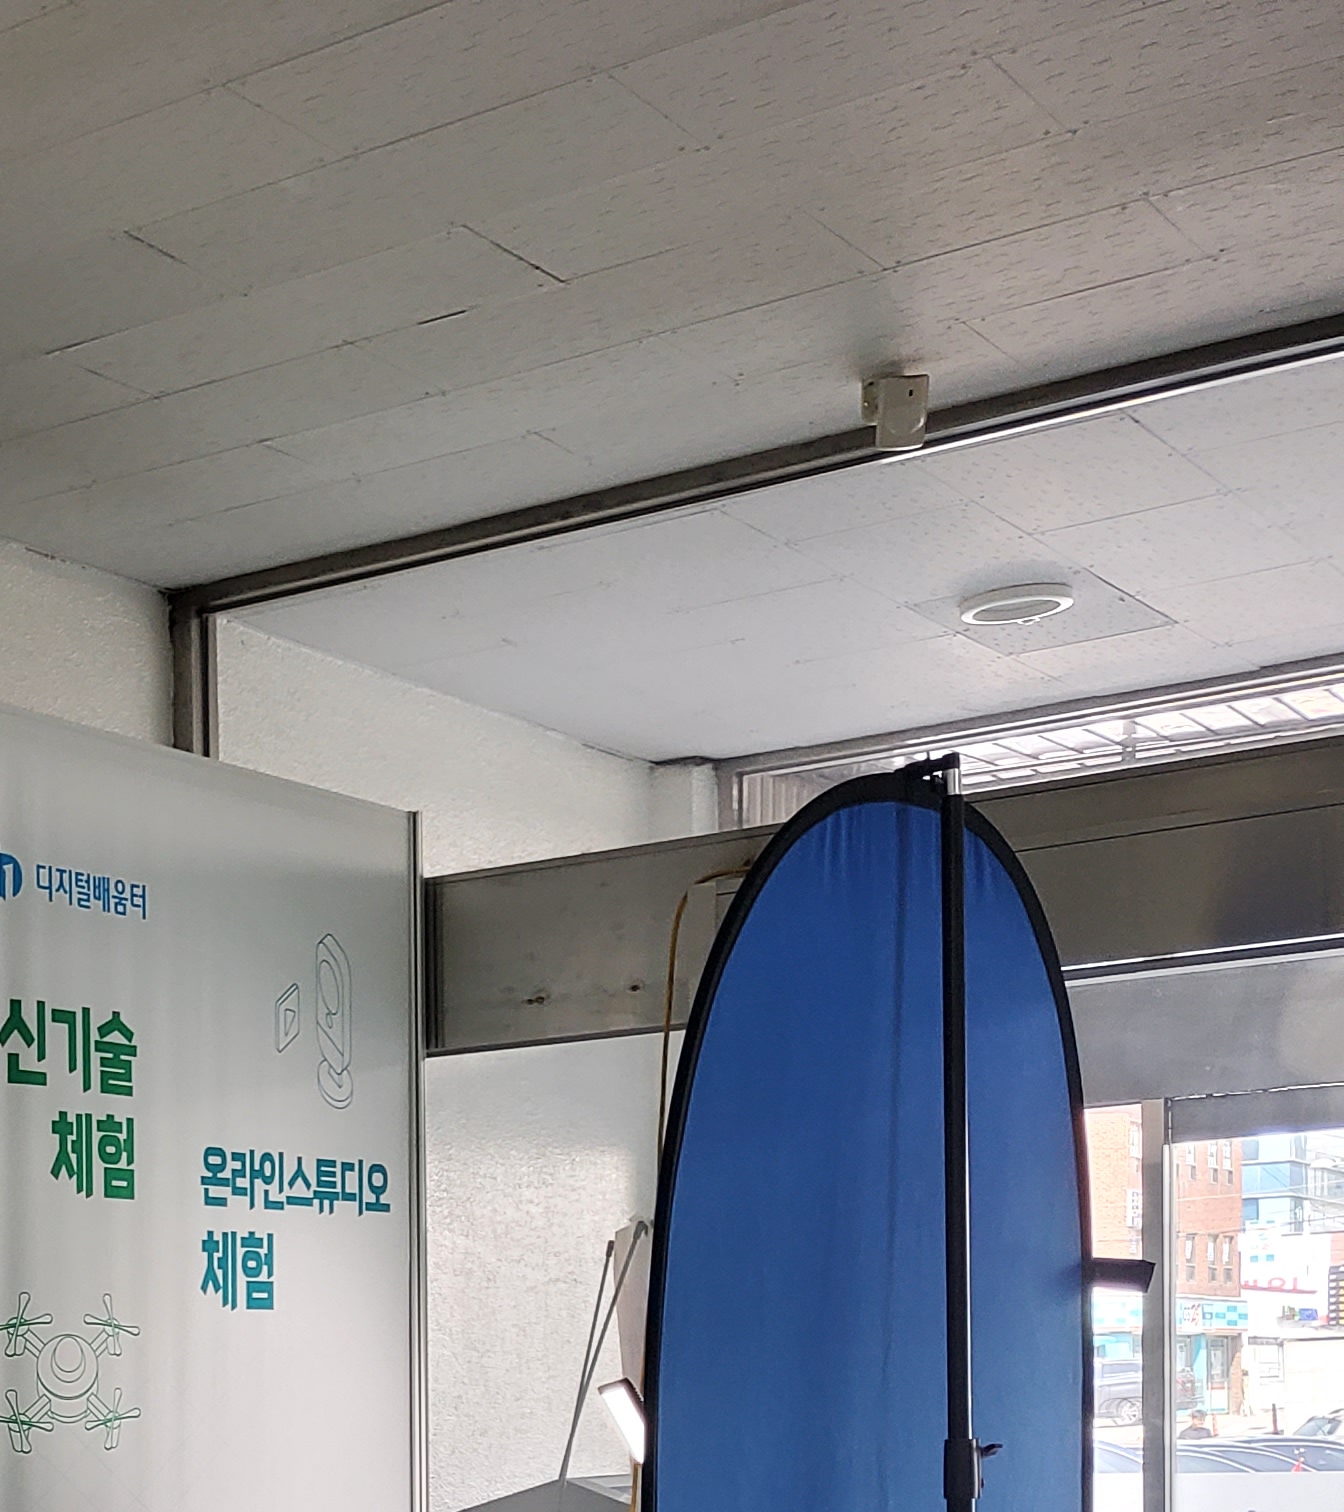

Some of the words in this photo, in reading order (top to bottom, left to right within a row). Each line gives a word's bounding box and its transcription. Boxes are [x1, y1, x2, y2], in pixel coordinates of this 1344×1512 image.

[35, 863, 148, 920] 디지털배움터
[50, 1110, 136, 1200] 체험
[200, 1146, 391, 1216] 온라인스튜디오
[200, 1230, 275, 1311] 체험
